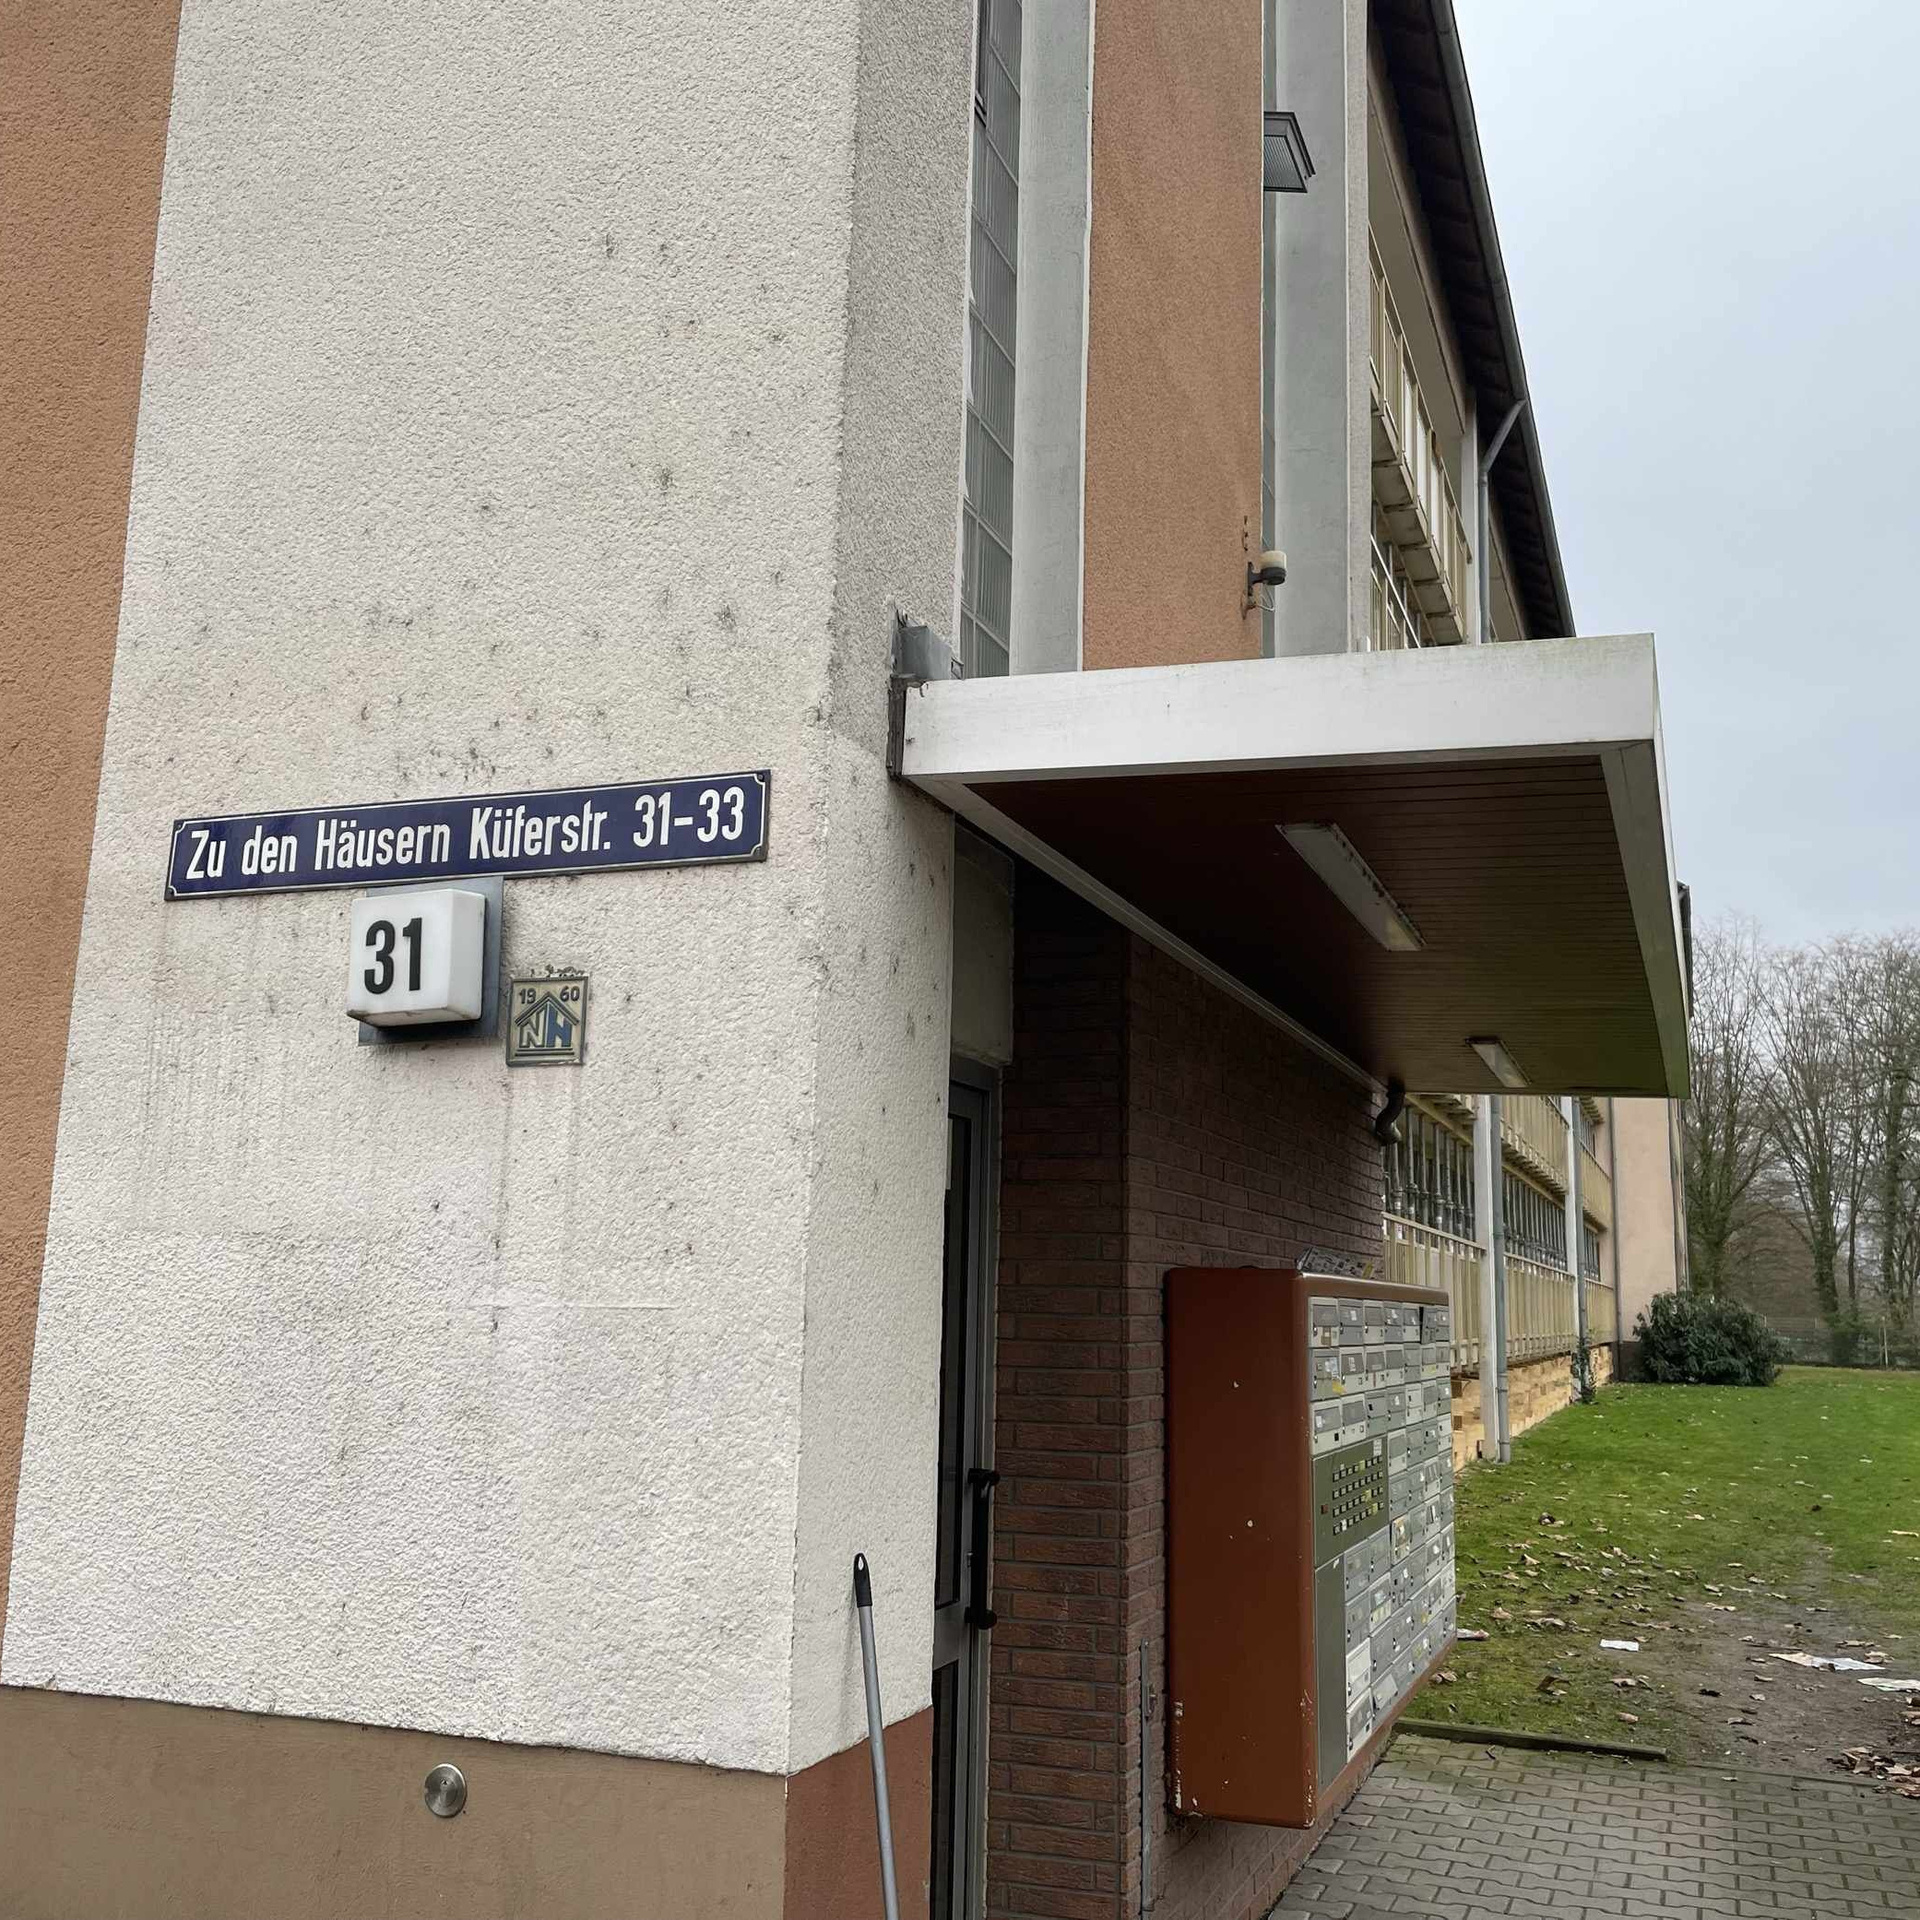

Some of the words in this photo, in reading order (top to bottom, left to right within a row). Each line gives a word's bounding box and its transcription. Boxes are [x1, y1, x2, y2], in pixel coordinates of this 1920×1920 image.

[186, 830, 225, 880] Zu
[241, 825, 297, 876] den
[314, 817, 451, 870] Häusern
[470, 801, 611, 859] Küferstr.
[364, 917, 424, 995] 31
[518, 987, 536, 1005] 19
[559, 985, 580, 1002] 60
